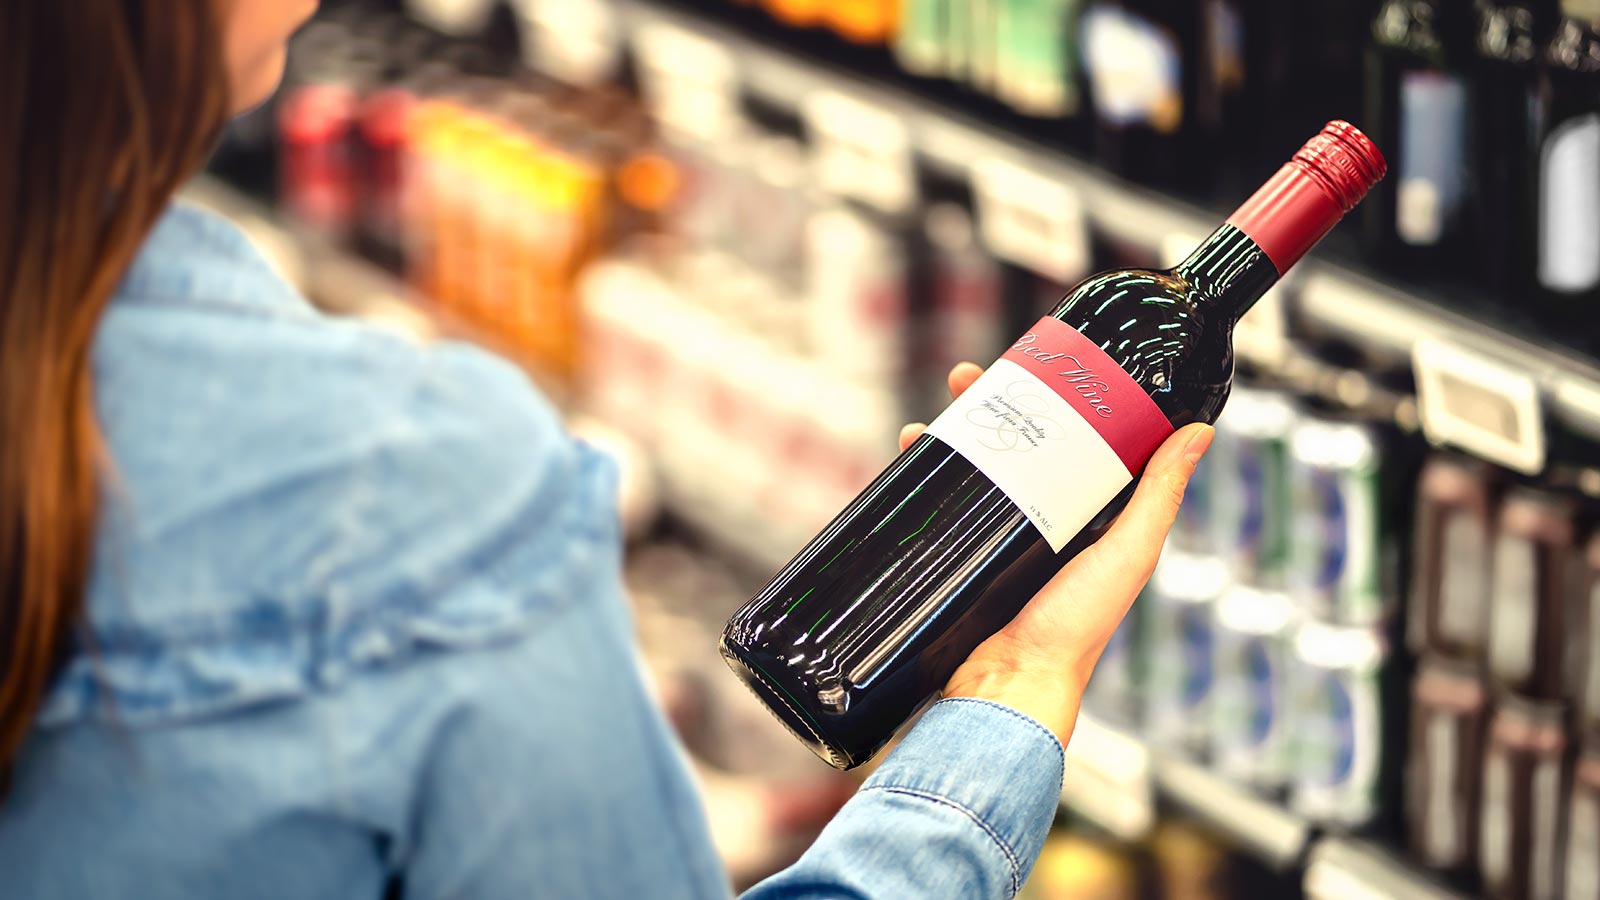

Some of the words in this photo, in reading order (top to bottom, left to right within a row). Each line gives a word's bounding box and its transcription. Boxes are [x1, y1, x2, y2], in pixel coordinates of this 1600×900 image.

[1012, 332, 1064, 364] Red
[1057, 355, 1113, 418] Wine
[981, 399, 1000, 413] Wine
[995, 412, 1017, 426] from
[990, 393, 1023, 416] Premium
[1022, 416, 1046, 439] Quality
[1040, 517, 1053, 531] ALC
